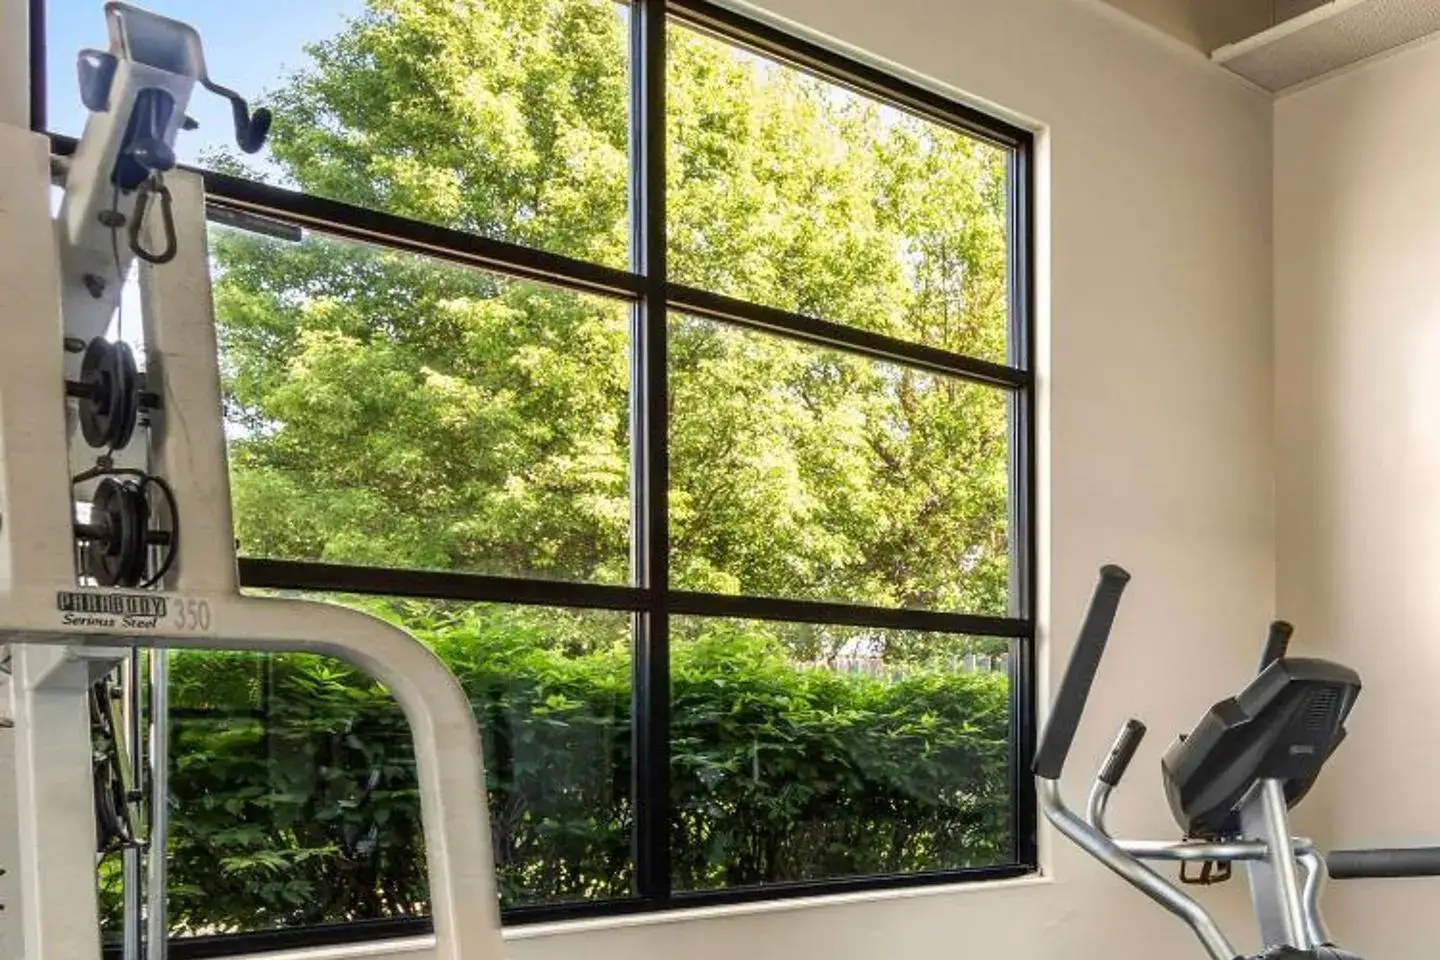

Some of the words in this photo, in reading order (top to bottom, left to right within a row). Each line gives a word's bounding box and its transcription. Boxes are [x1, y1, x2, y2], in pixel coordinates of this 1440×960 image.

[62, 613, 115, 627] Serious
[121, 617, 158, 628] Steel
[173, 599, 211, 631] 350
